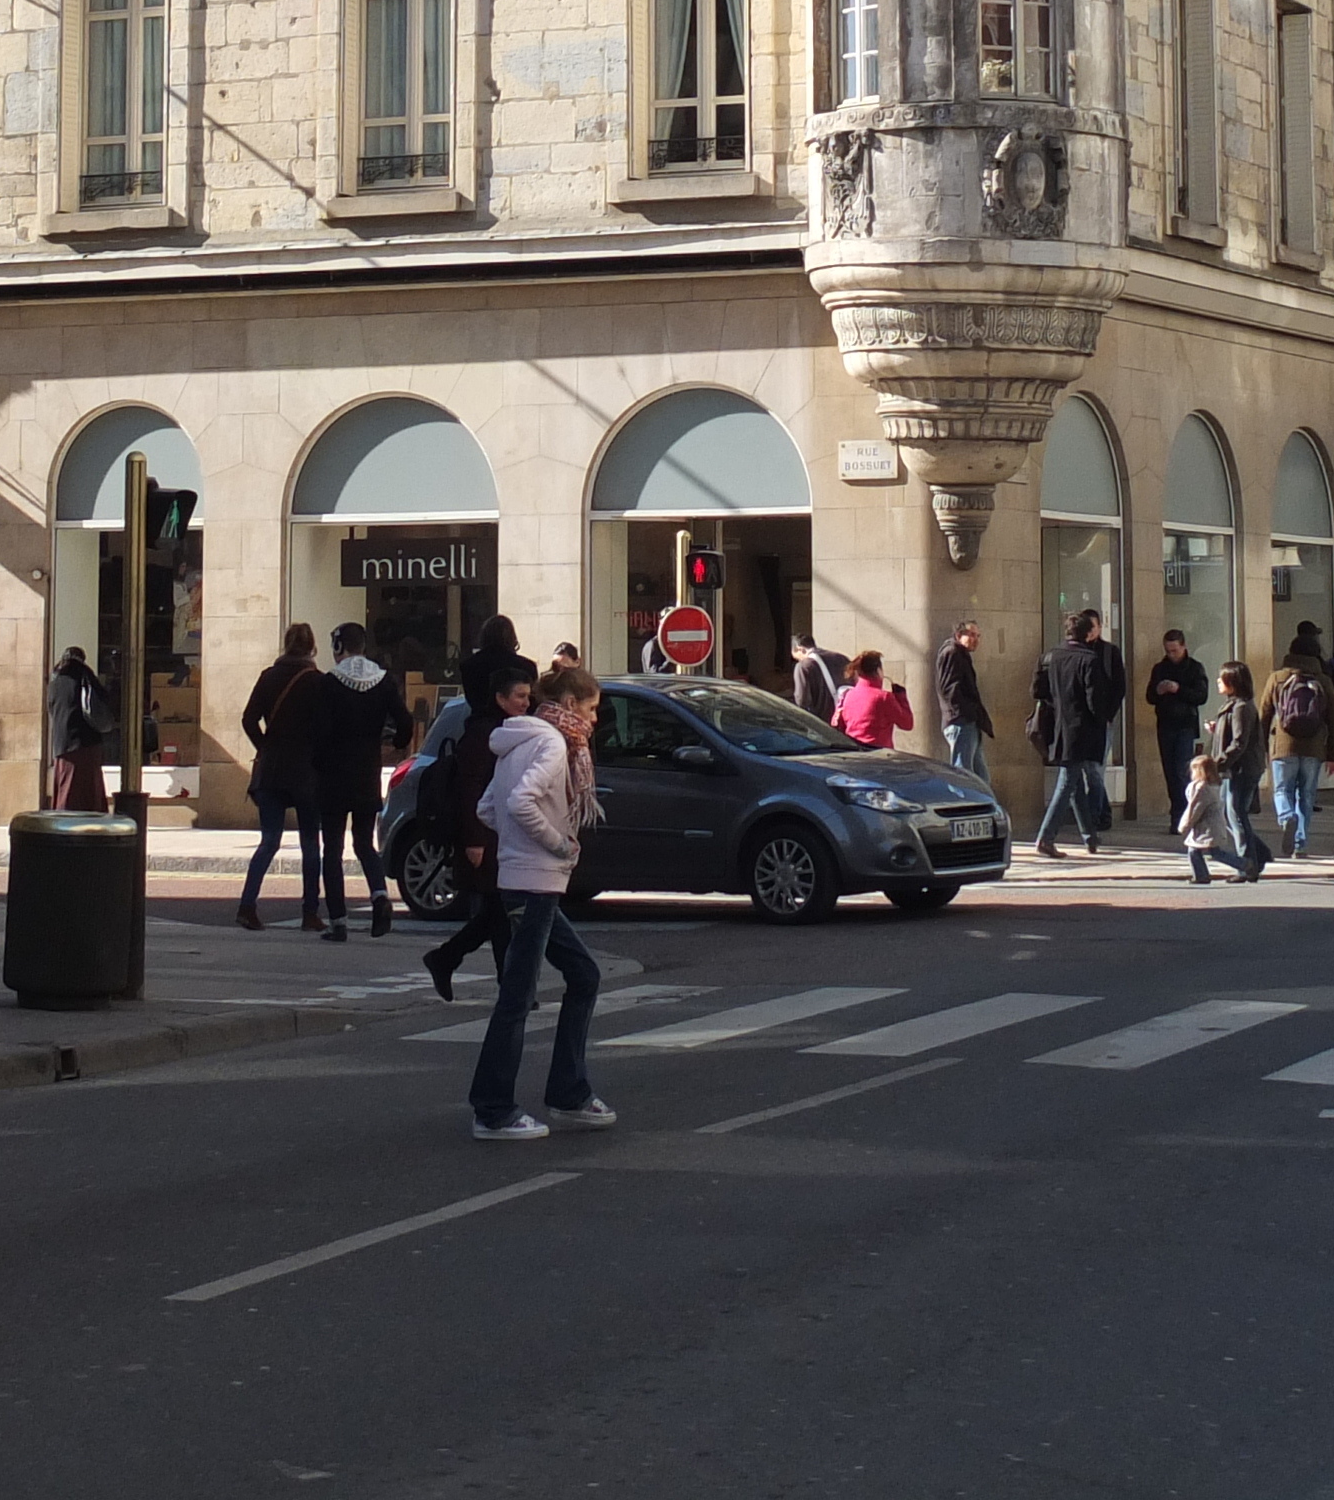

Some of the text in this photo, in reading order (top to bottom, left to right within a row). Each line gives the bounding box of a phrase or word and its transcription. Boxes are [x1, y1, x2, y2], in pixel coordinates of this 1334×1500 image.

[857, 447, 878, 457] RUE
[844, 460, 892, 471] BOSSUET
[362, 544, 477, 580] minelli
